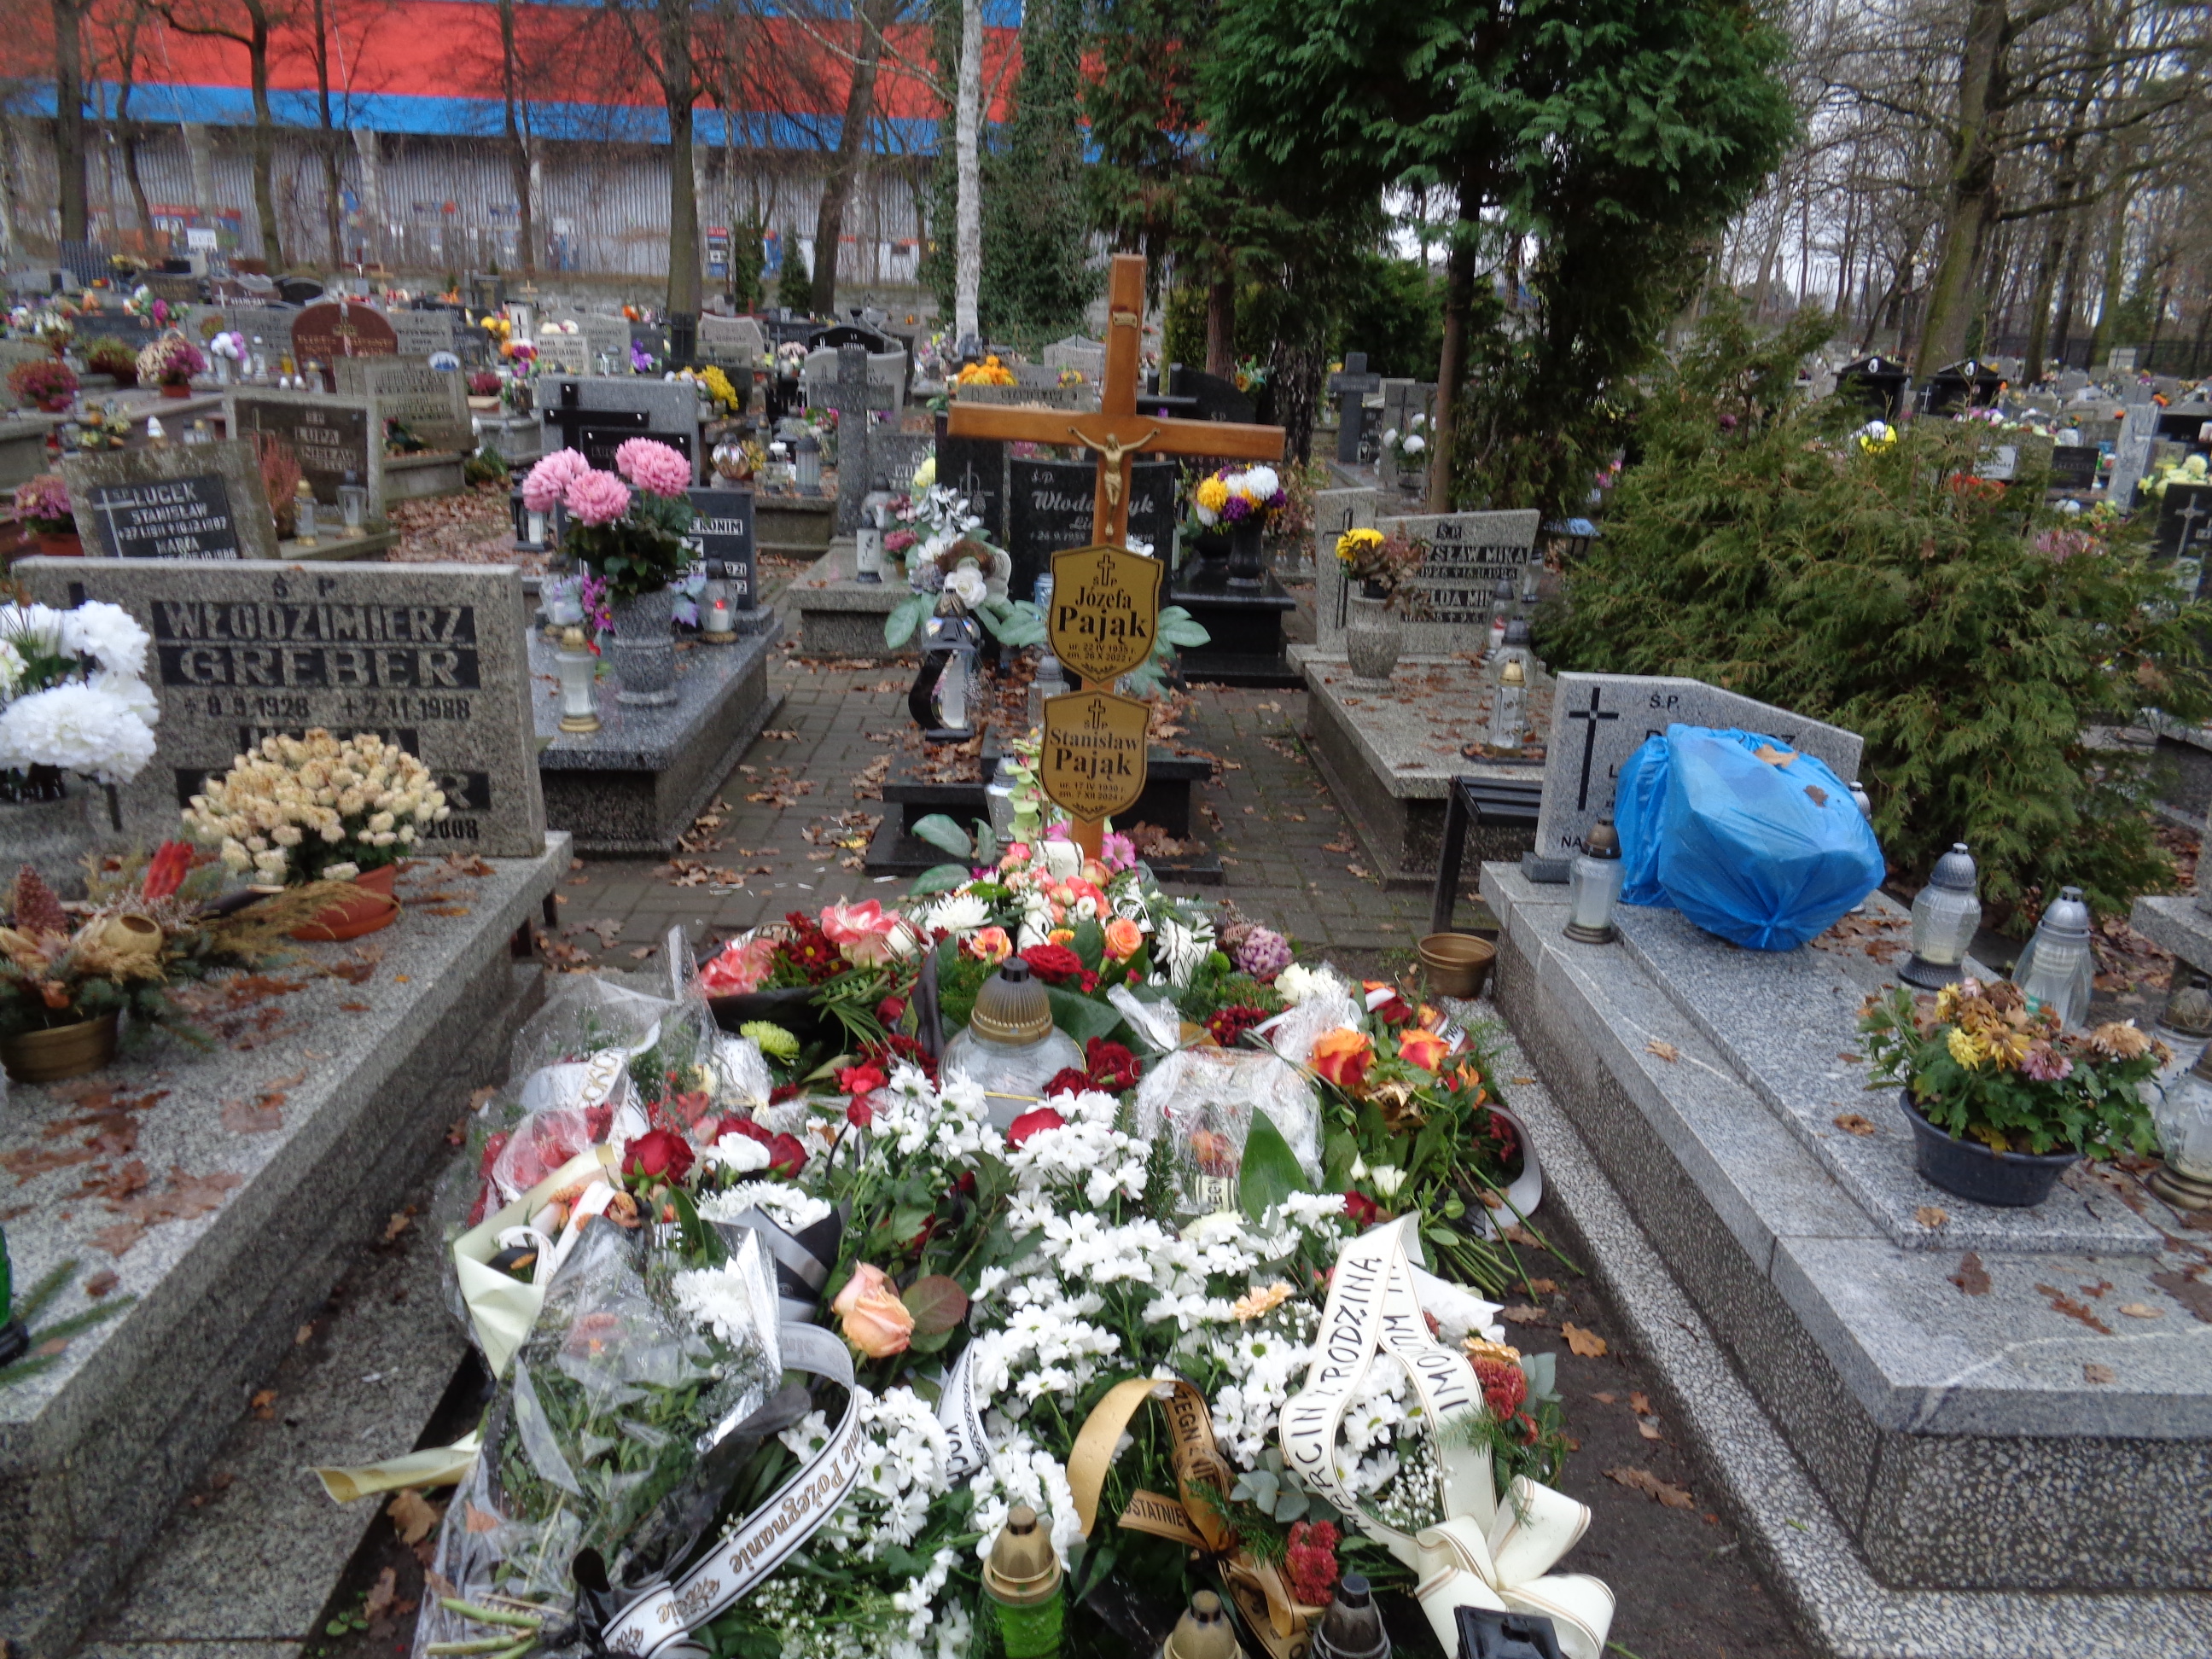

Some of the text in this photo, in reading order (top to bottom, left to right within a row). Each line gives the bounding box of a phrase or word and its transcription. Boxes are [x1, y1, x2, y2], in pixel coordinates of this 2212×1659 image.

[132, 481, 197, 507] LUCEK
[1075, 586, 1132, 609] Józefa
[163, 602, 466, 643] WŁODZIMIERZ
[1058, 607, 1147, 643] Pająk
[180, 649, 460, 687] GREBER
[1050, 727, 1140, 751] Stanisław
[1055, 748, 1132, 781] Pająk
